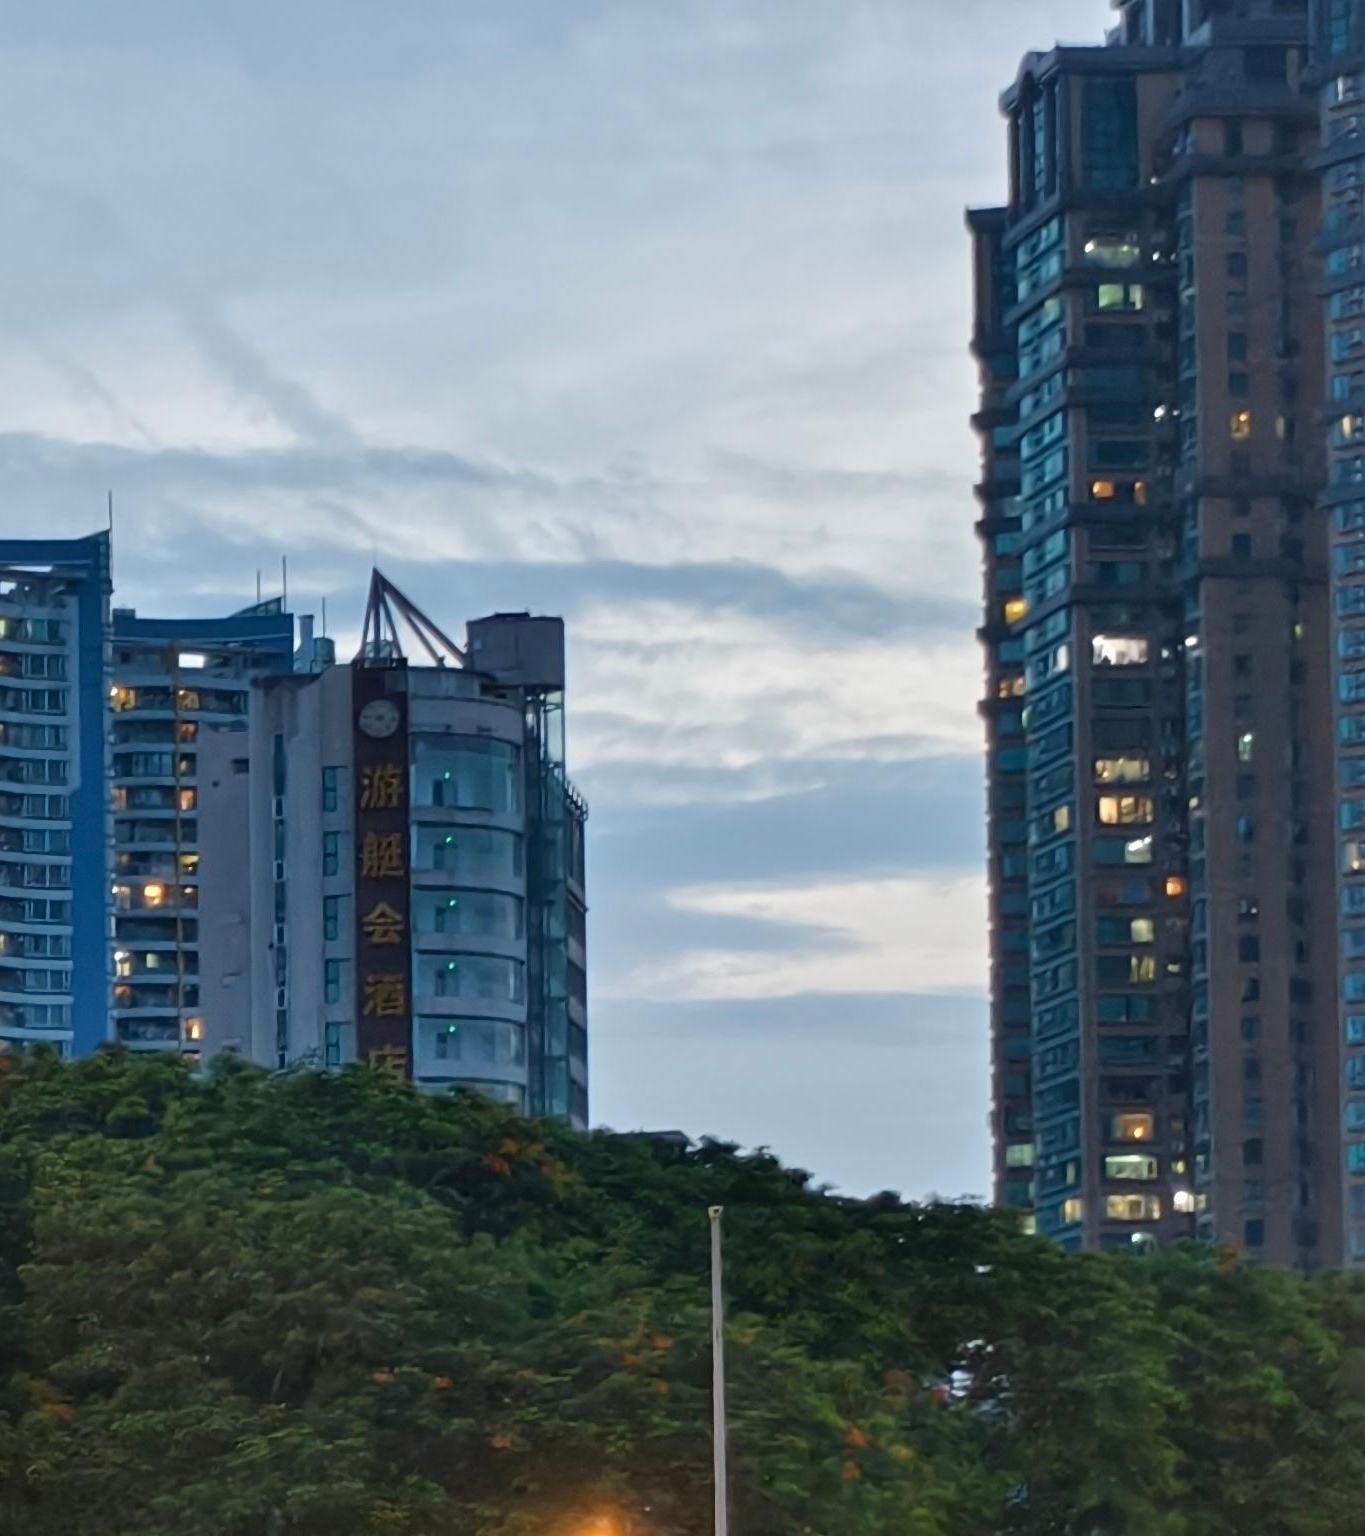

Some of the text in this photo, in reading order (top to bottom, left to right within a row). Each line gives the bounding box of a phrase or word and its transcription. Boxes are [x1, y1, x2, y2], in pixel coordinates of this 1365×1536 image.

[361, 765, 406, 1085] 游艇会酒店
